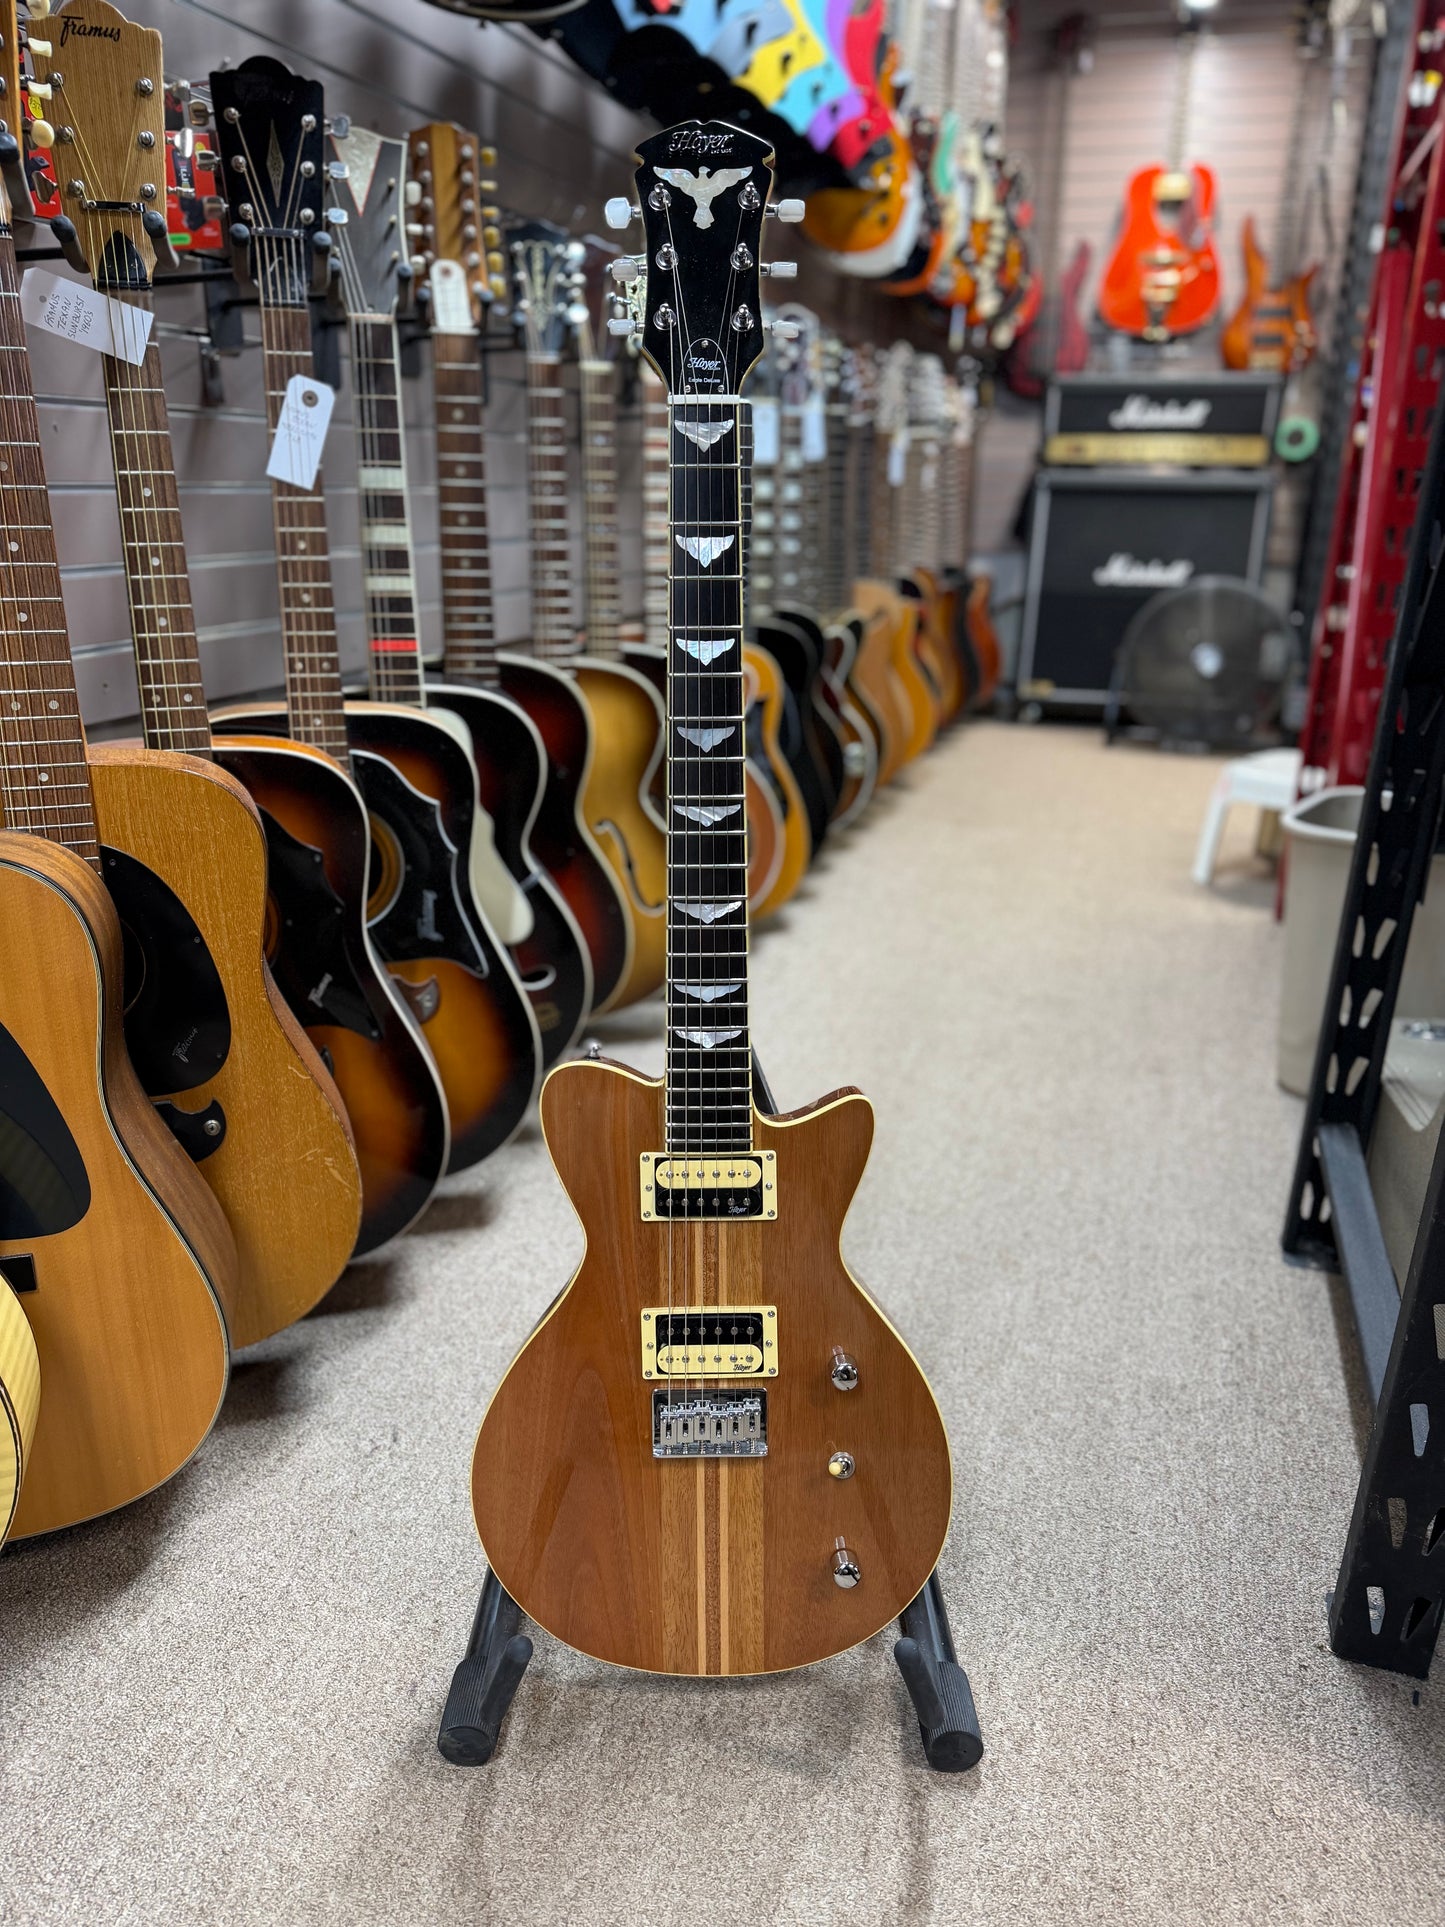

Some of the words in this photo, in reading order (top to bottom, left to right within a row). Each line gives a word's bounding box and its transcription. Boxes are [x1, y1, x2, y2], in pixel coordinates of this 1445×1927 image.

[60, 15, 121, 48] Framus
[668, 129, 734, 154] Hoyer
[57, 296, 72, 331] TEXAN
[67, 294, 86, 340] SUNBURST
[686, 357, 721, 370] Hoyer
[172, 1025, 199, 1064] Framus
[733, 1364, 752, 1372] Hoyer
